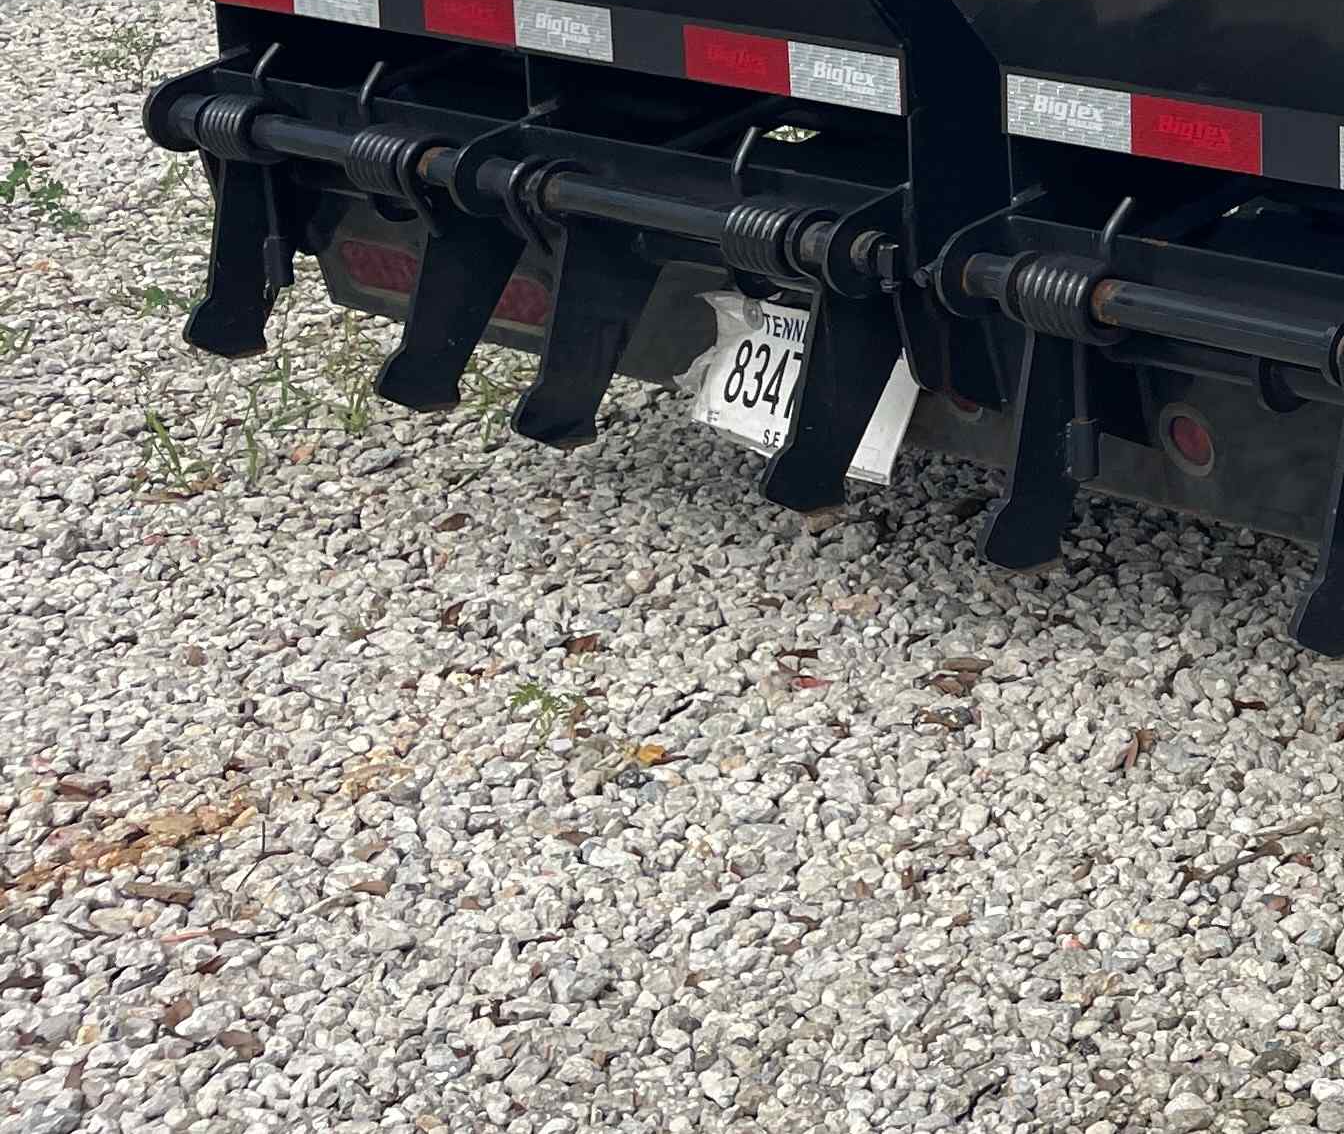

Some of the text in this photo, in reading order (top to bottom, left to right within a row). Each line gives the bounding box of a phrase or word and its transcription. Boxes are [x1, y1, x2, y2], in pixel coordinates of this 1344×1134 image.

[535, 12, 591, 37] BigTex
[813, 60, 875, 87] BigTex
[1033, 93, 1104, 123] BigTex
